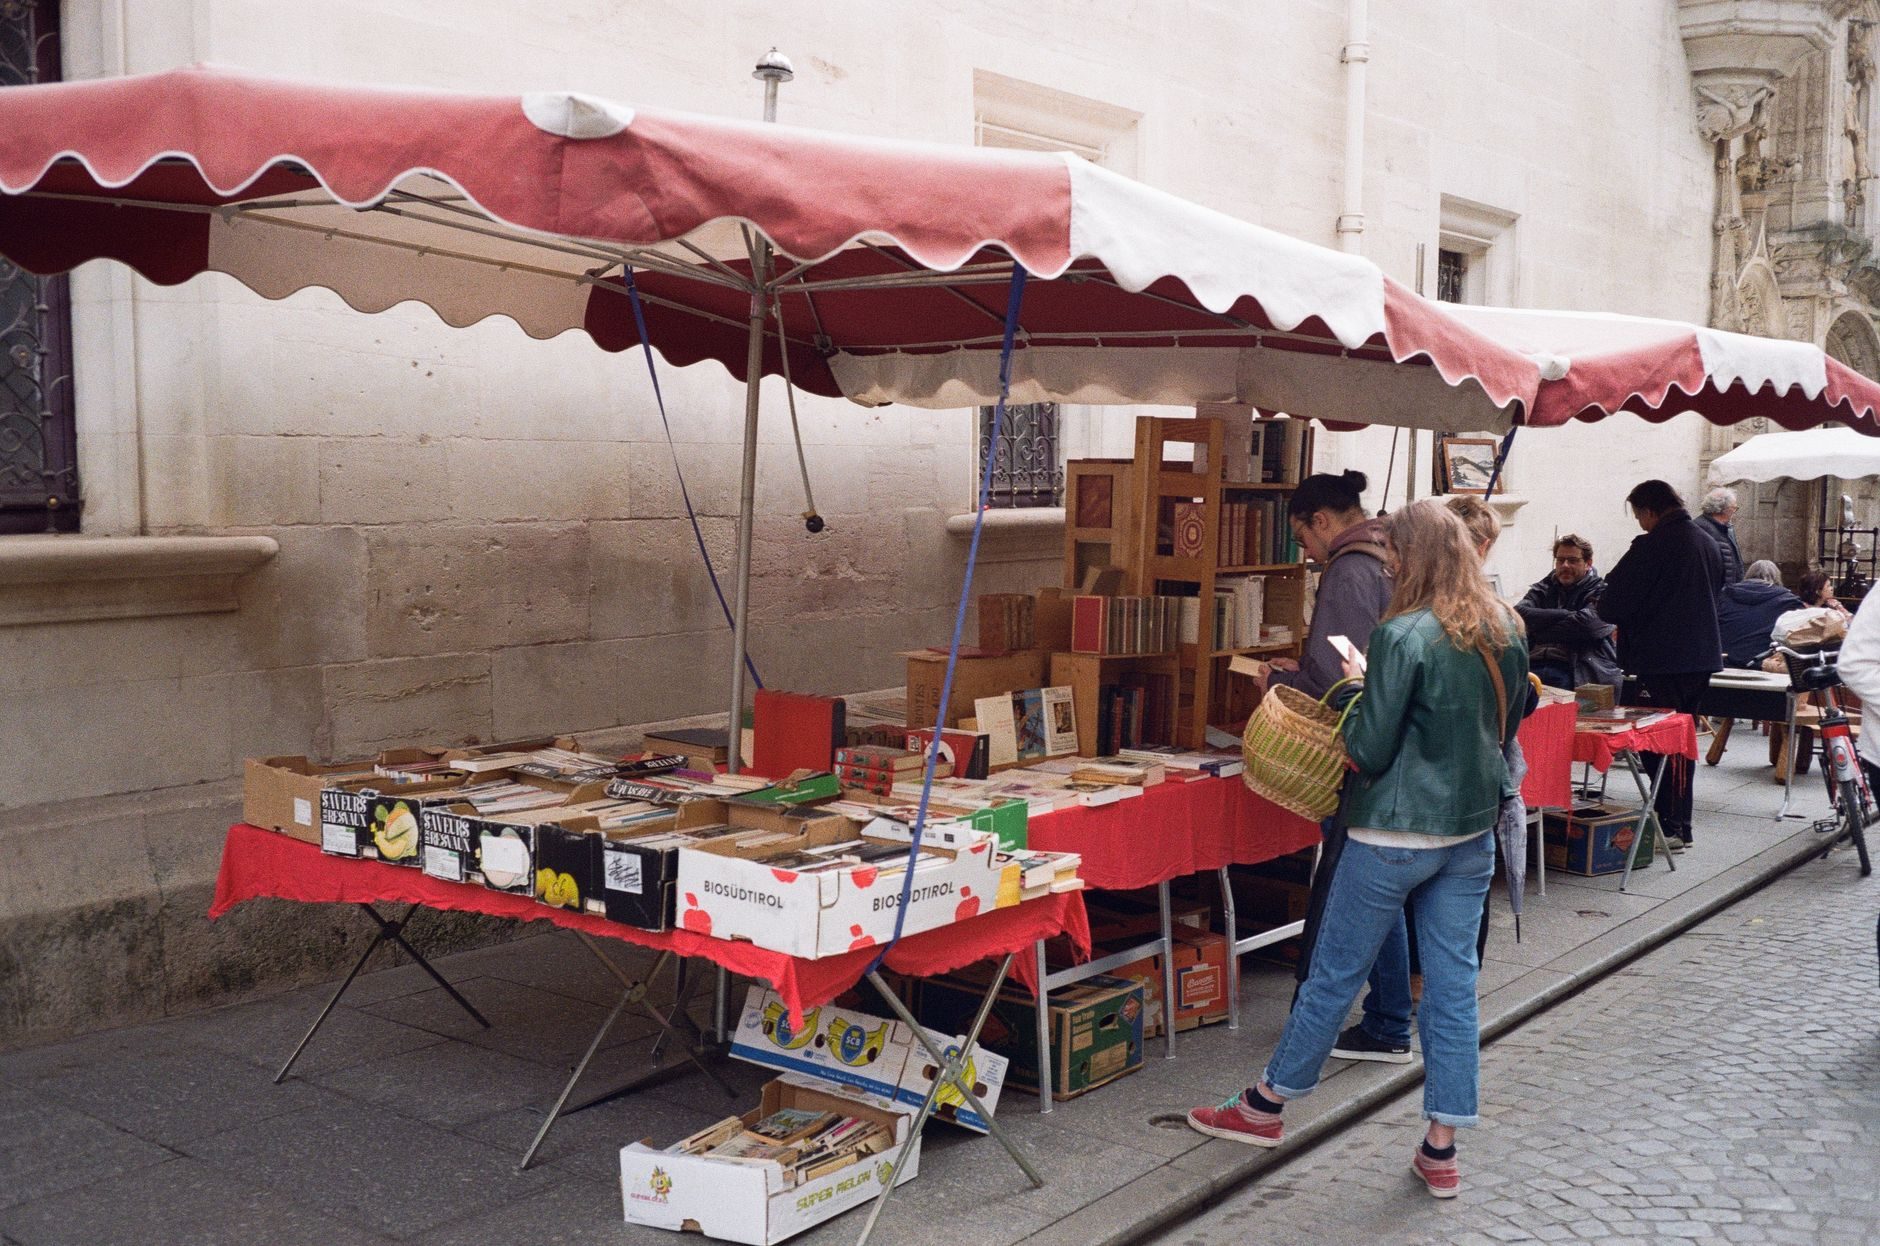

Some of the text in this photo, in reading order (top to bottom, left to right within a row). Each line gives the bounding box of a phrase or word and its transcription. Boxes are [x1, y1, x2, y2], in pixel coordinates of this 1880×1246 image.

[321, 792, 367, 813] SAVEURS
[423, 813, 470, 838] SAVEURS
[703, 880, 784, 909] BIOSÜDTIROL
[873, 881, 955, 912] BIOSDTIROL
[846, 1036, 861, 1046] SCB
[796, 1186, 834, 1212] SUPER
